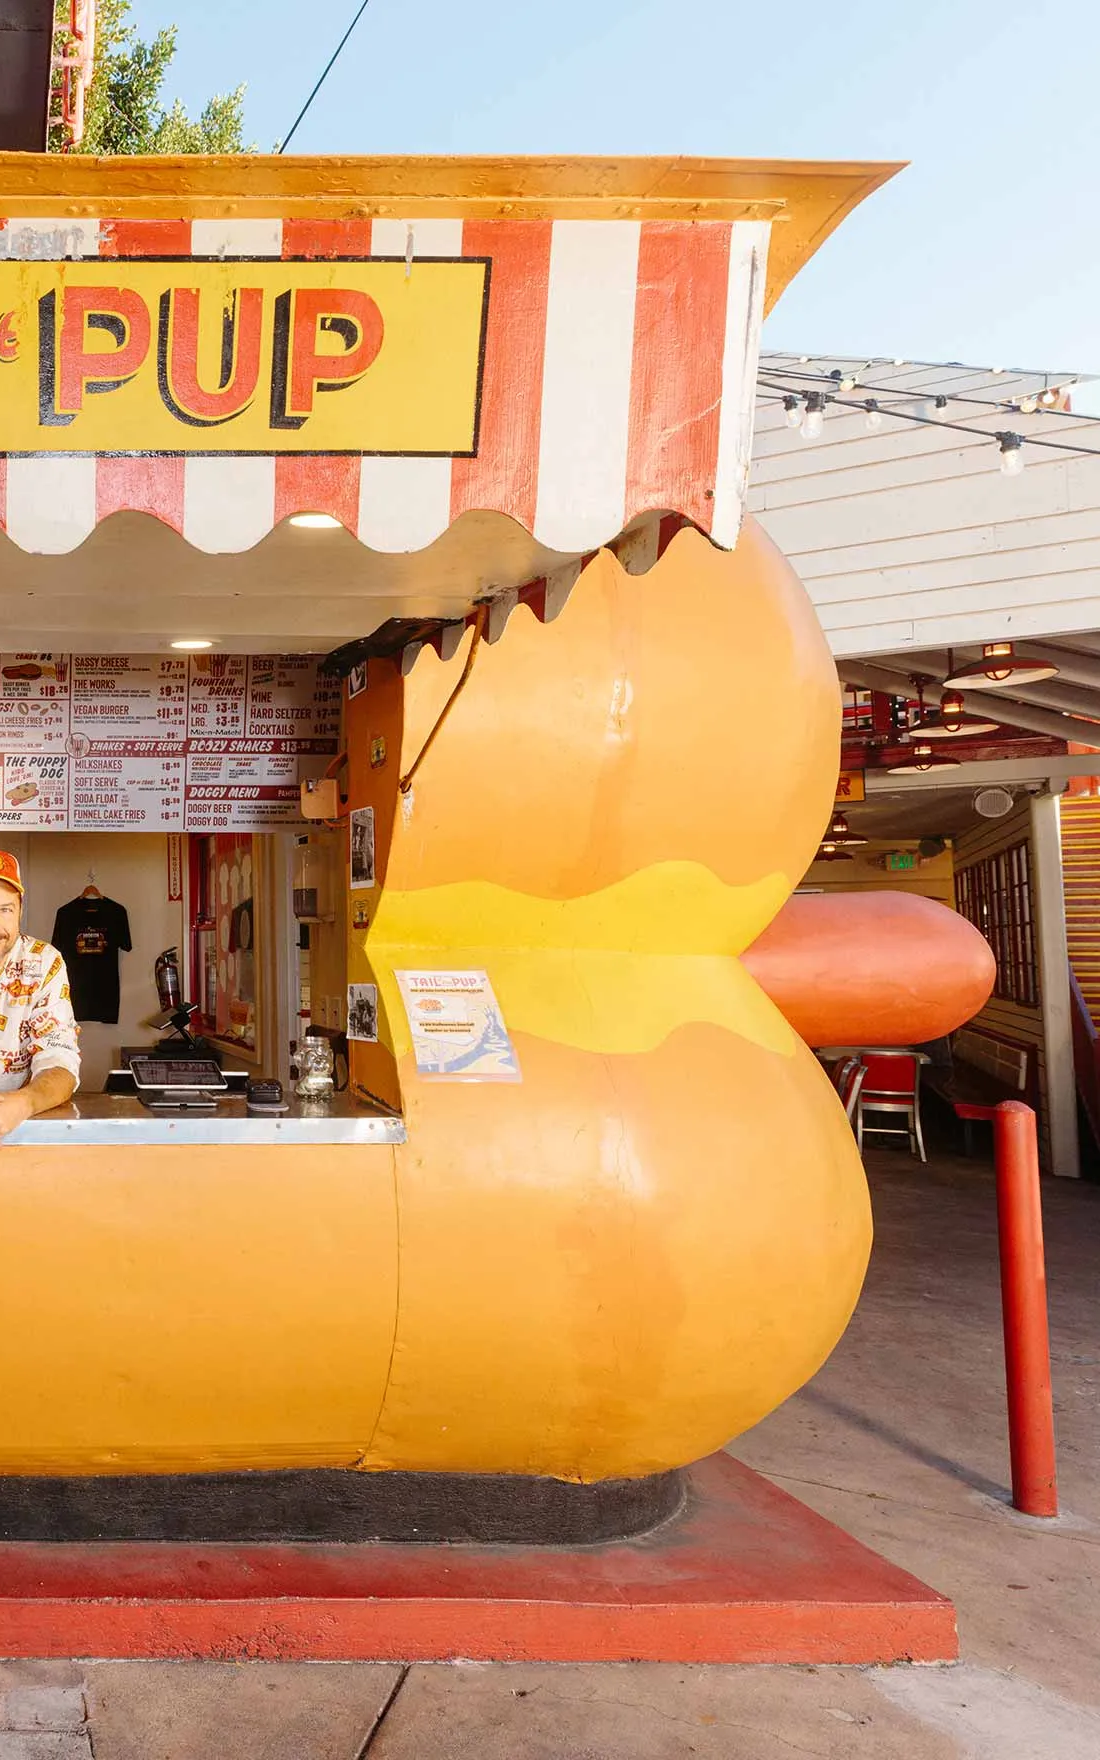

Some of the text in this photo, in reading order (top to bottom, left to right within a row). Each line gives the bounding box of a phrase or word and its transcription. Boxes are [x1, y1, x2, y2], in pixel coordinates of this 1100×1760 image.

[38, 286, 385, 429] PUP
[74, 657, 129, 668] SASSY CHEESE
[252, 659, 274, 671] BEER
[74, 679, 116, 689] THE WORKS
[191, 677, 235, 687] FOUNTAIN
[208, 687, 245, 697] DRINKS
[250, 691, 273, 703] WINE
[73, 705, 129, 715] VEGAN BURGER
[191, 703, 210, 713] MED.
[250, 707, 312, 719] HARD SELTZER
[5, 716, 26, 724] CHEESE
[26, 716, 43, 724] FRIES
[7, 730, 24, 738] RINGS
[249, 724, 295, 736] COCKTAILS
[90, 742, 184, 751] SHAKES SOFT SERVE
[189, 740, 274, 752] BOOZY SHAKES
[5, 756, 26, 767] THE
[28, 756, 67, 767] PUPPY
[74, 759, 123, 769] MILKSHAKES
[10, 768, 25, 776] KIDS
[40, 768, 64, 778] DOG
[5, 776, 21, 784] LOVE
[74, 777, 94, 787] SOFT
[94, 777, 118, 787] SERVE
[189, 787, 227, 799] DOGGY
[228, 787, 260, 799] MENU
[74, 794, 118, 804] SODA FLOAT
[187, 803, 212, 814] DOGGY
[213, 803, 232, 814] BEER
[74, 810, 146, 819] FUNNEL CAKE FRIES
[187, 816, 211, 826] DOGGY
[212, 816, 228, 826] DOG
[891, 854, 914, 870] EXIT
[410, 976, 478, 987] TAIL PUP
[31, 1010, 49, 1028] PUP
[0, 1048, 24, 1058] TAIL
